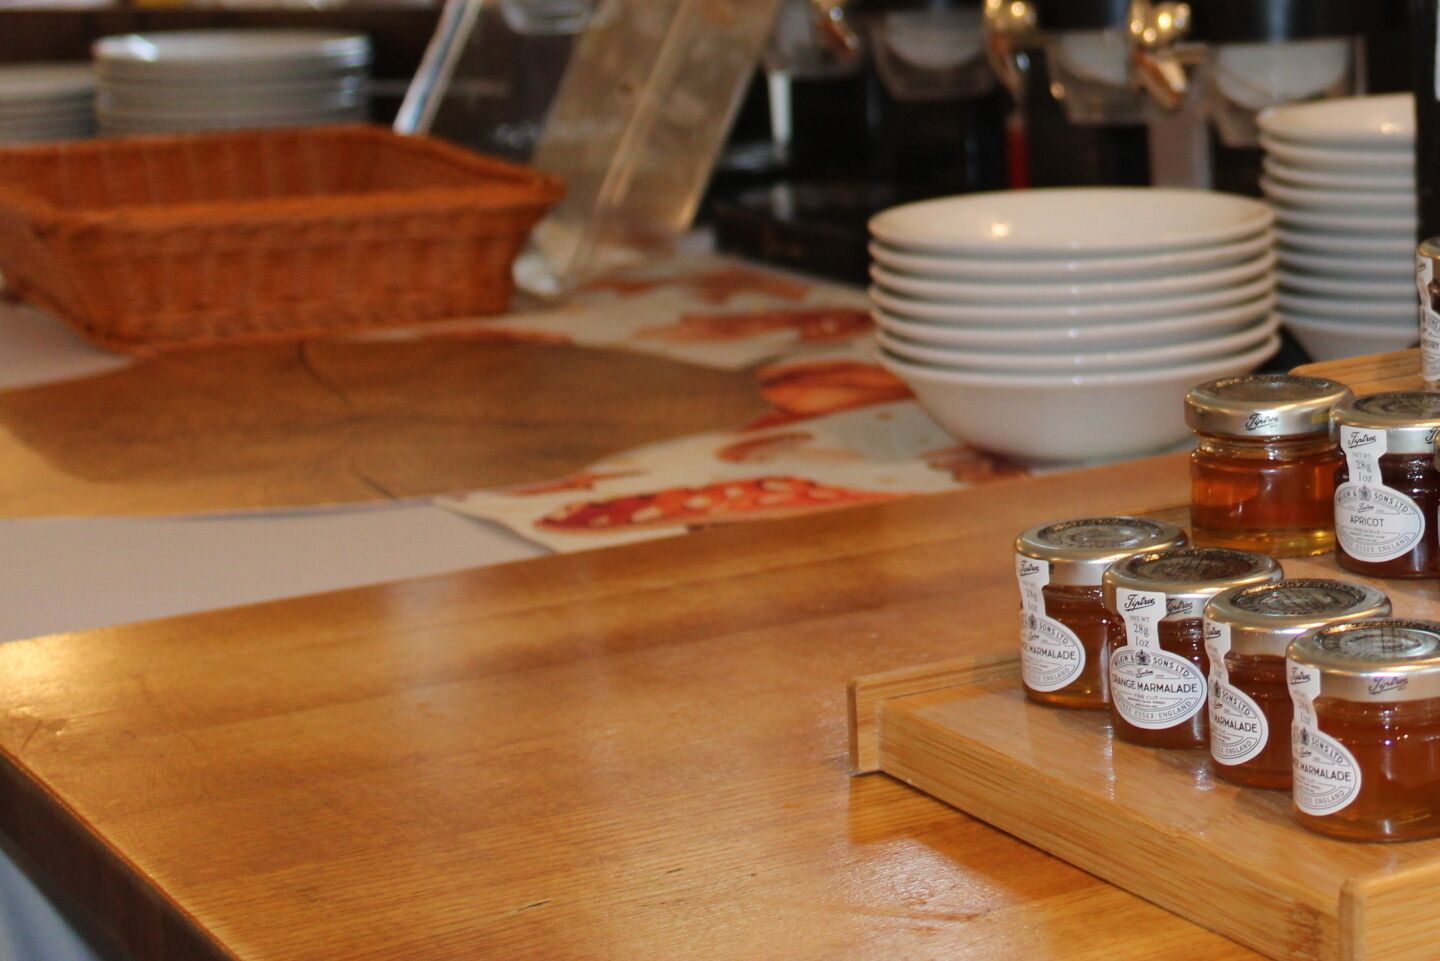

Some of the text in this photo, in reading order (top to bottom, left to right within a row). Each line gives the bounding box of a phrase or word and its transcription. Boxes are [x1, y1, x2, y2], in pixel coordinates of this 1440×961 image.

[1347, 431, 1377, 449] Tiptree
[1358, 471, 1373, 483] 1oz
[1374, 492, 1394, 505] SONS
[1394, 500, 1409, 513] LTD
[1350, 515, 1385, 527] APRICOT
[1378, 536, 1410, 552] ENGLAND
[1123, 594, 1156, 612] Tiptree
[1133, 624, 1150, 638] 28g
[1135, 636, 1150, 648] 1oz
[1029, 644, 1077, 660] MARMALADE
[1153, 657, 1174, 670] SONS
[1175, 665, 1190, 679] LTD
[1112, 673, 1198, 693] RANGE MARMALADE
[1158, 701, 1191, 718] ENGLAND
[1238, 701, 1251, 716] LTD
[1225, 739, 1253, 754] ENGLAND
[1311, 737, 1343, 764] SONS LTD
[1299, 762, 1352, 782] MARMALADE
[1314, 789, 1345, 804] ENGLAND
